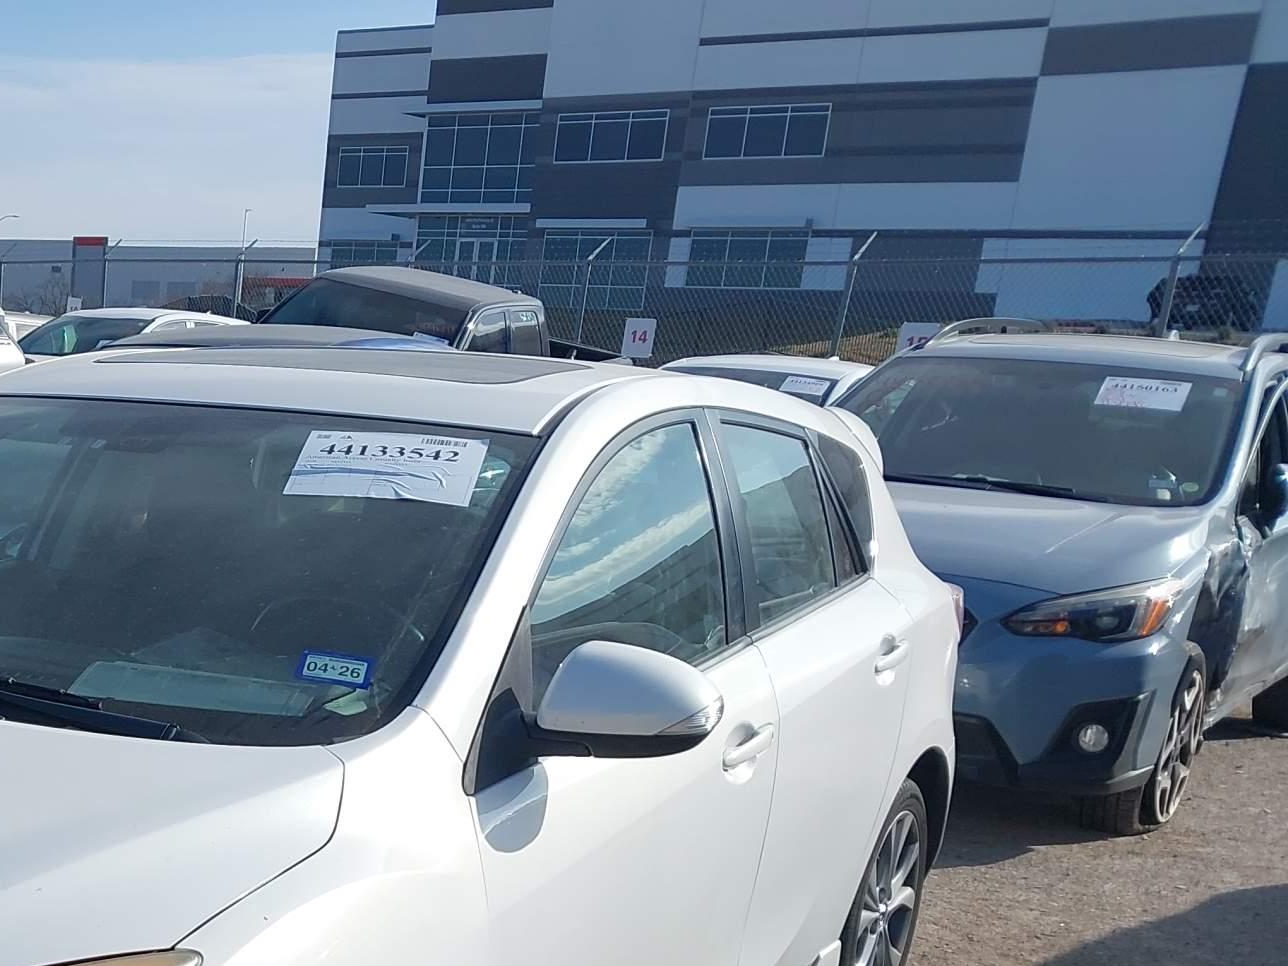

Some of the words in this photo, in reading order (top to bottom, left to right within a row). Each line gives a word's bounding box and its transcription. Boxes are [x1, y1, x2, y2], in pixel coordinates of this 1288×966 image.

[631, 330, 649, 344] 14
[319, 443, 460, 463] 44133542
[306, 661, 329, 674] 04
[338, 665, 362, 679] 26
